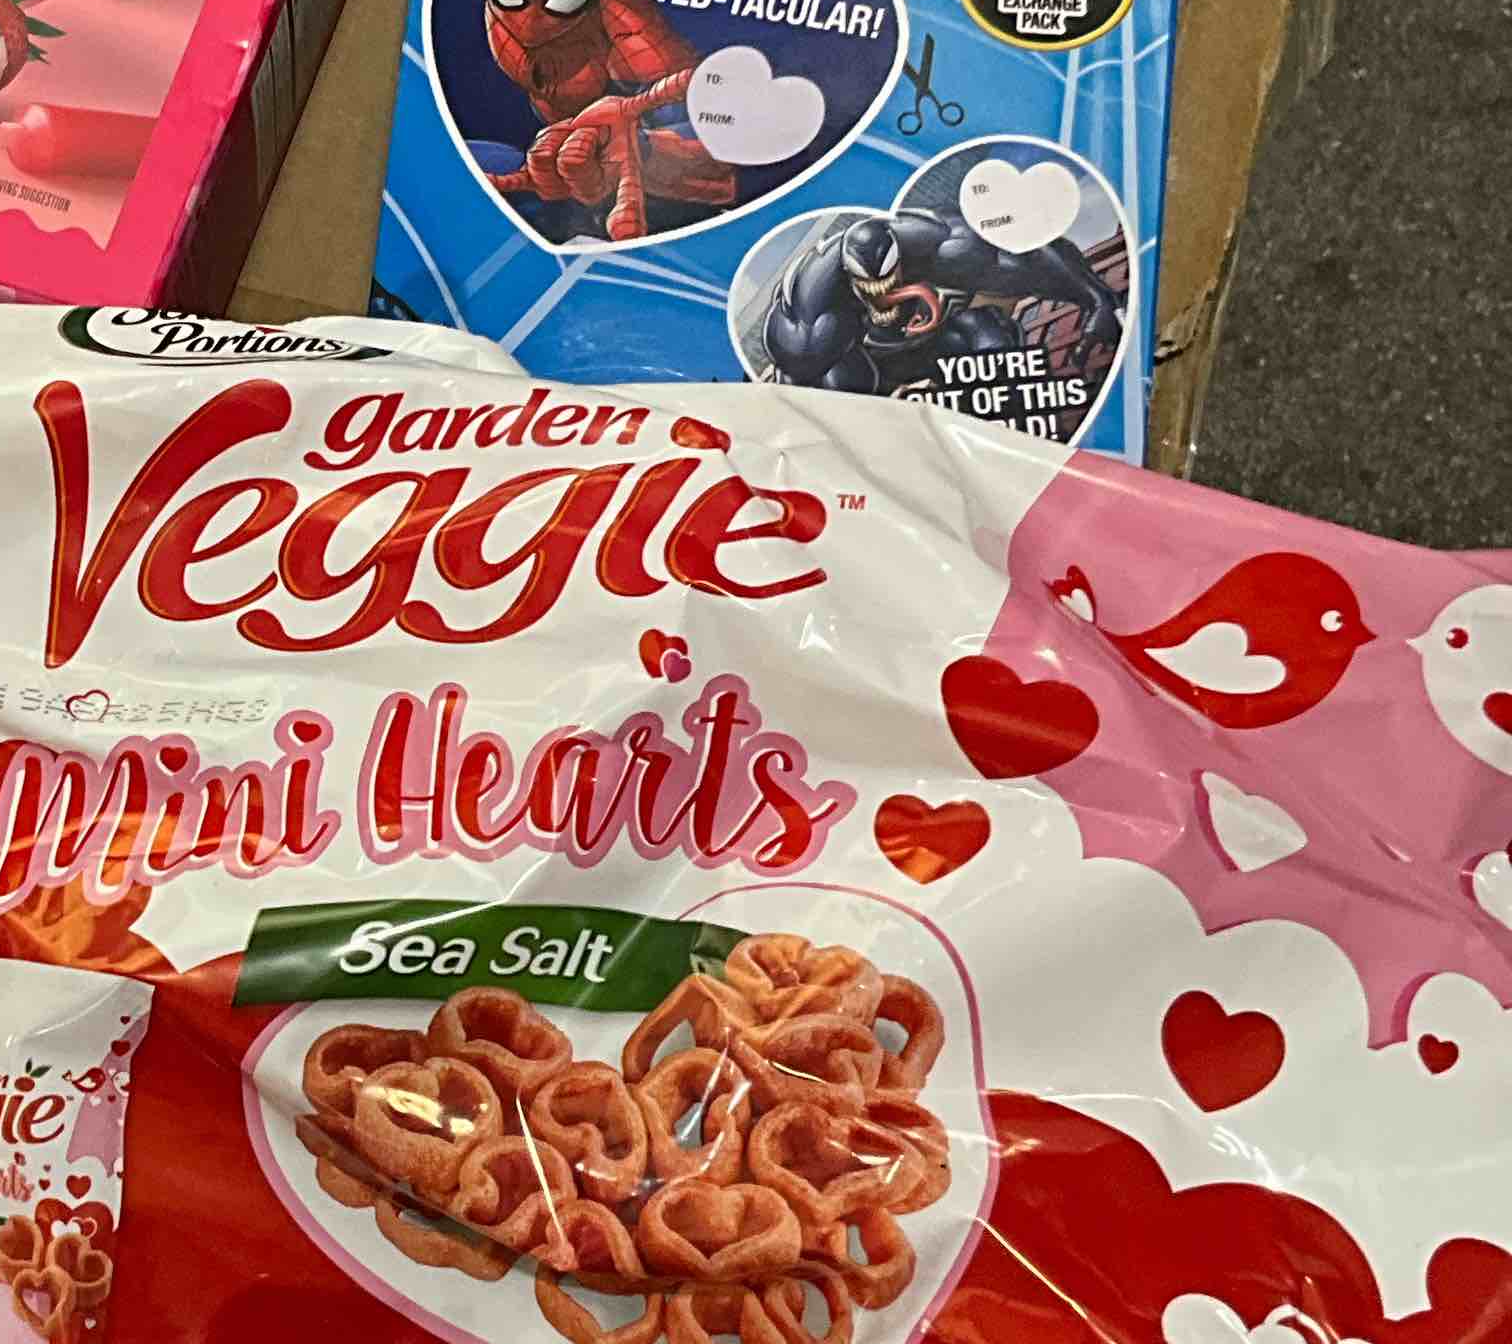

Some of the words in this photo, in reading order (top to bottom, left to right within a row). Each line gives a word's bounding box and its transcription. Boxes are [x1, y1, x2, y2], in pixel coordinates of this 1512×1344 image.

[1022, 12, 1060, 30] PACK
[706, 73, 724, 86] TO:
[698, 112, 736, 126] FROM:
[17, 185, 72, 212] SUGGESTION
[150, 321, 345, 355] Portions
[937, 349, 1046, 385] YOU'RE
[972, 384, 1009, 415] OF
[1016, 378, 1088, 411] THIS
[304, 388, 648, 472] garden
[34, 380, 829, 668] Veggie
[368, 678, 850, 870] Hearts
[337, 921, 476, 980] Sea
[491, 922, 615, 988] Salt
